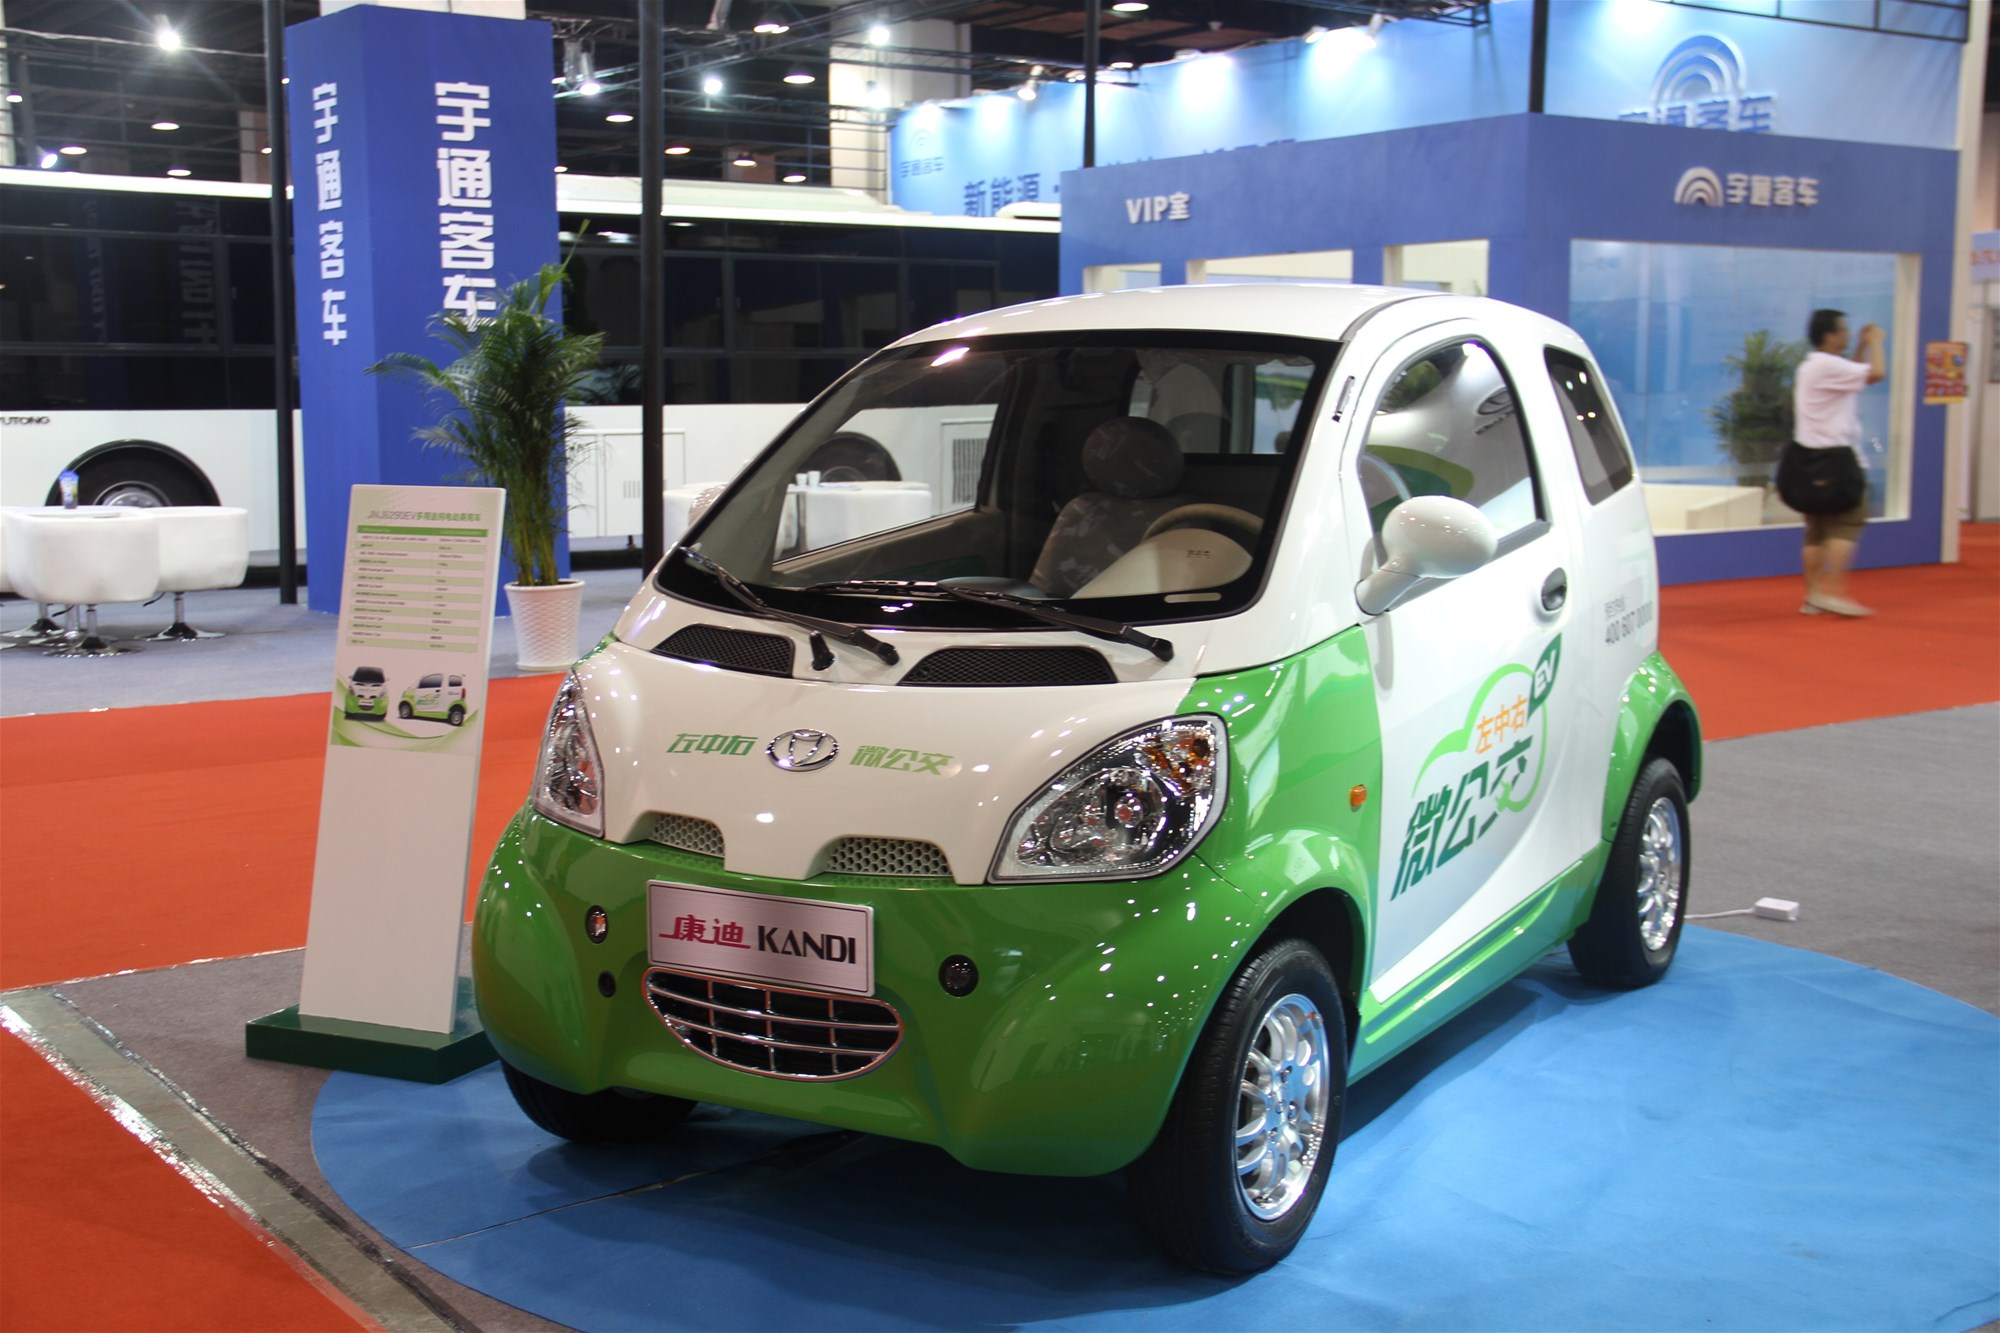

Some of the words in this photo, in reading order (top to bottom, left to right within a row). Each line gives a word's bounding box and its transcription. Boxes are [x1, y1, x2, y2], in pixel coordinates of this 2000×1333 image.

[1619, 95, 1772, 132] 通客车
[313, 82, 348, 346] 宇通客车
[434, 82, 497, 332] 宇通客车
[1126, 191, 1191, 224] VIP室
[1726, 172, 1820, 206] 宇通客车
[1533, 648, 1558, 700] EV
[1475, 694, 1529, 755] 左中右
[667, 733, 759, 756] 左中右
[849, 745, 953, 776] 微公交
[1390, 735, 1534, 902] 微公交
[659, 914, 752, 949] 康迪
[757, 925, 856, 965] KANDI
